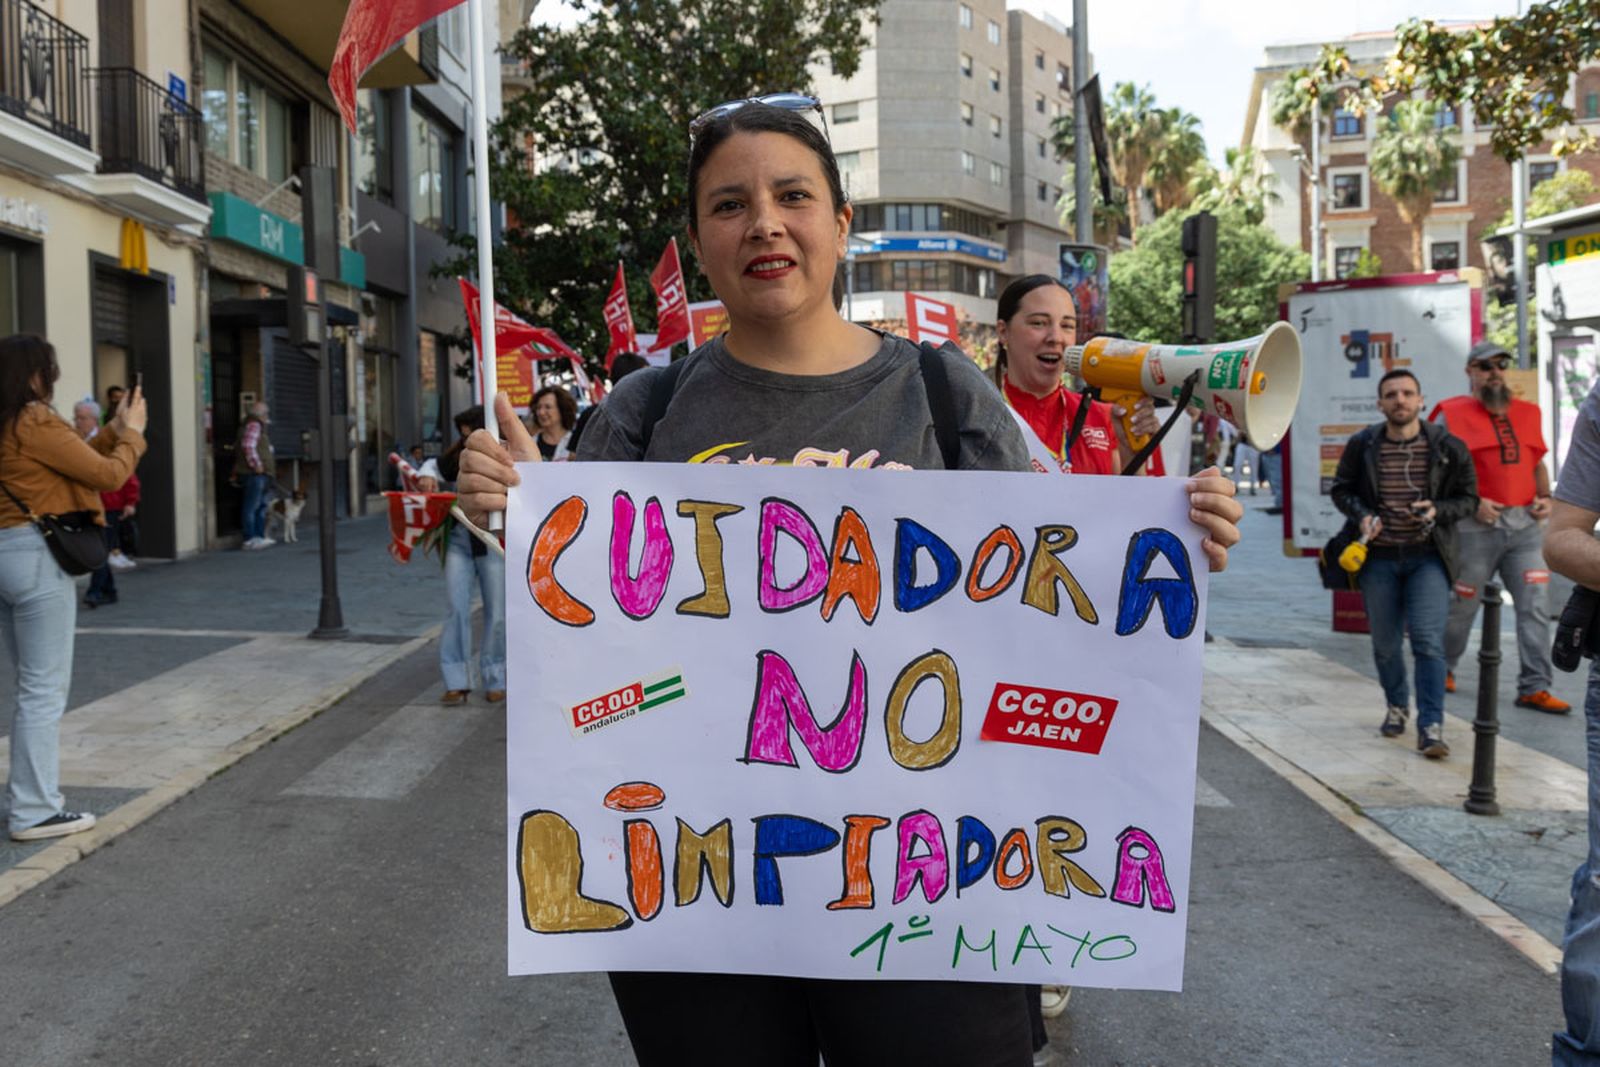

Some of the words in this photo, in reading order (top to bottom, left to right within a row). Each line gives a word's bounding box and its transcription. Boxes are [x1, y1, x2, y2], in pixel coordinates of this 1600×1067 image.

[526, 489, 1199, 640] CUIDADORA
[577, 688, 641, 723] CC.OO.
[583, 707, 637, 734] andalucia
[736, 648, 963, 774] NO
[997, 689, 1105, 726] CC.OO.
[1007, 720, 1082, 743] JAEN
[952, 923, 1137, 972] MAYO
